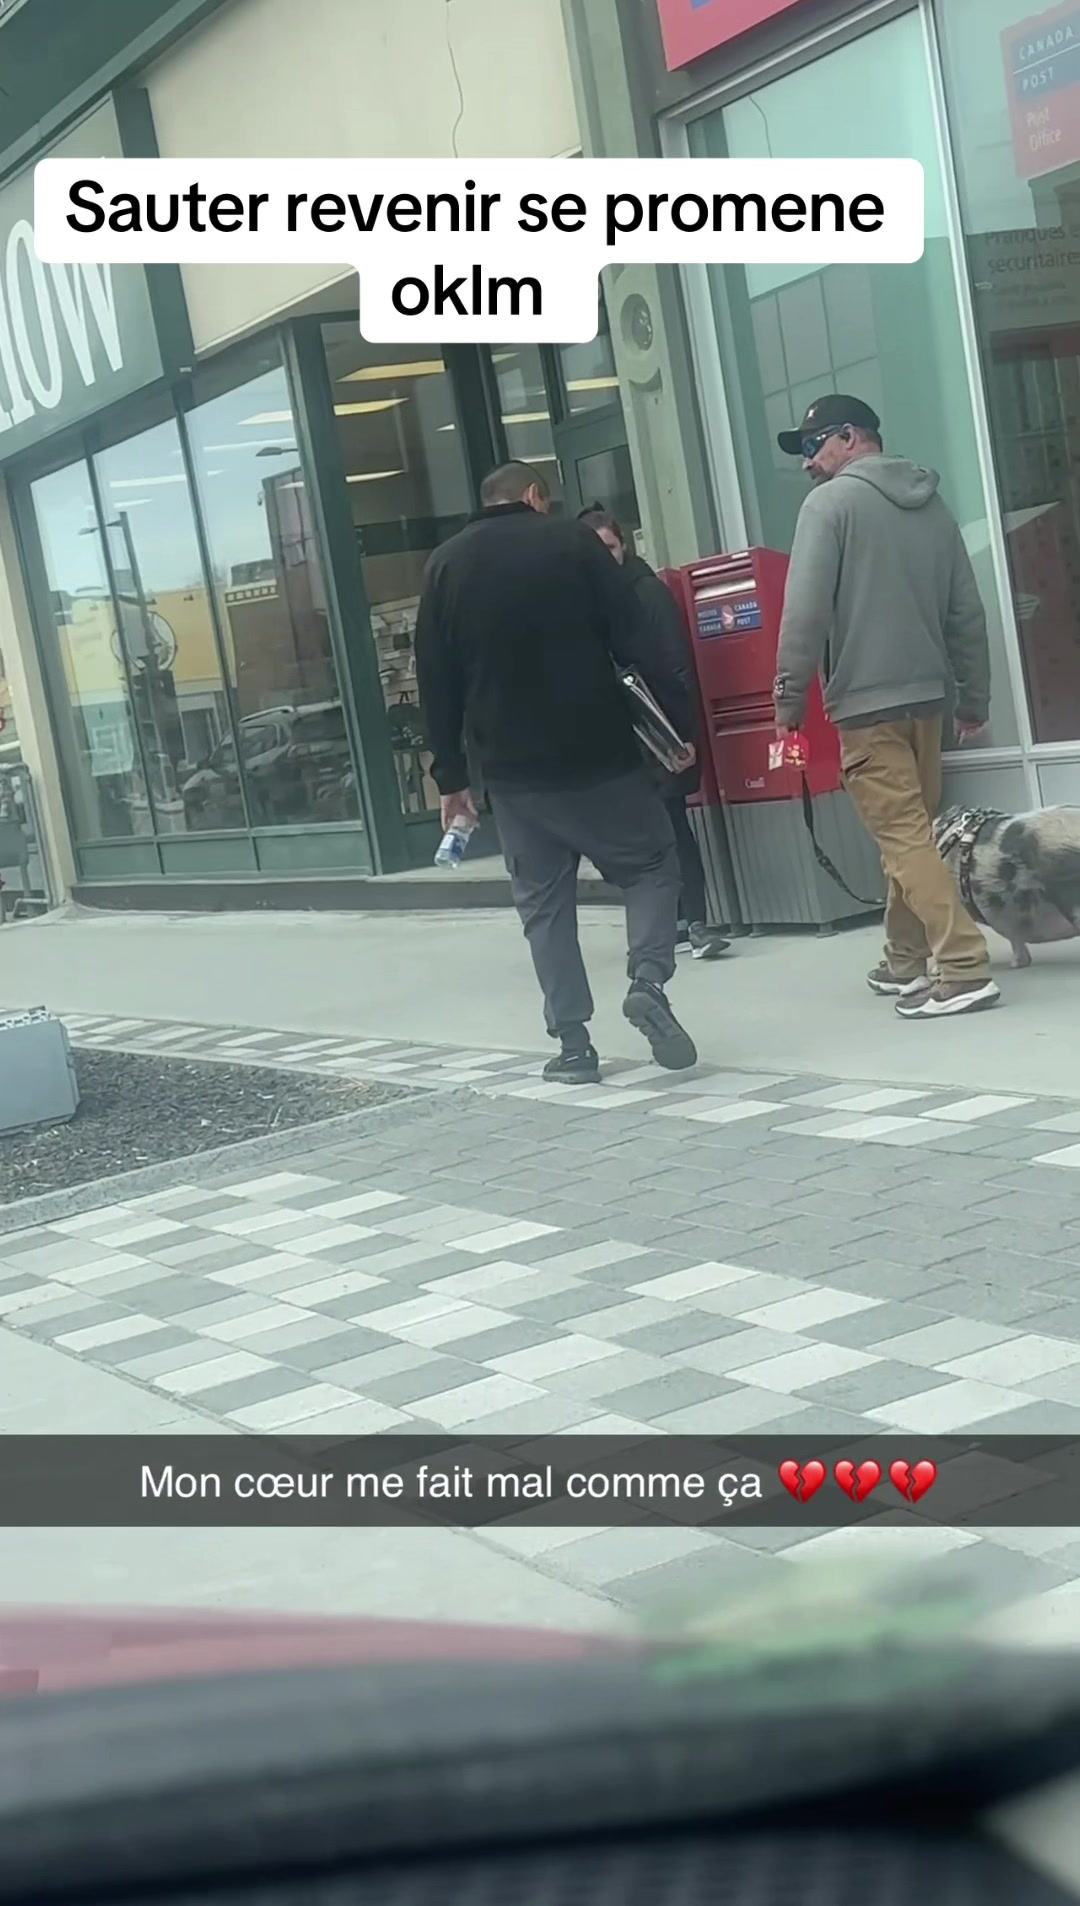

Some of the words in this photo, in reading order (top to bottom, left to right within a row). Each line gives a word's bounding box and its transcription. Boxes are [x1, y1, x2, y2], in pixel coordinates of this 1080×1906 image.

[1019, 25, 1074, 60] CANADA
[1022, 66, 1054, 91] POST
[1025, 106, 1050, 127] Post
[1030, 128, 1062, 151] Office
